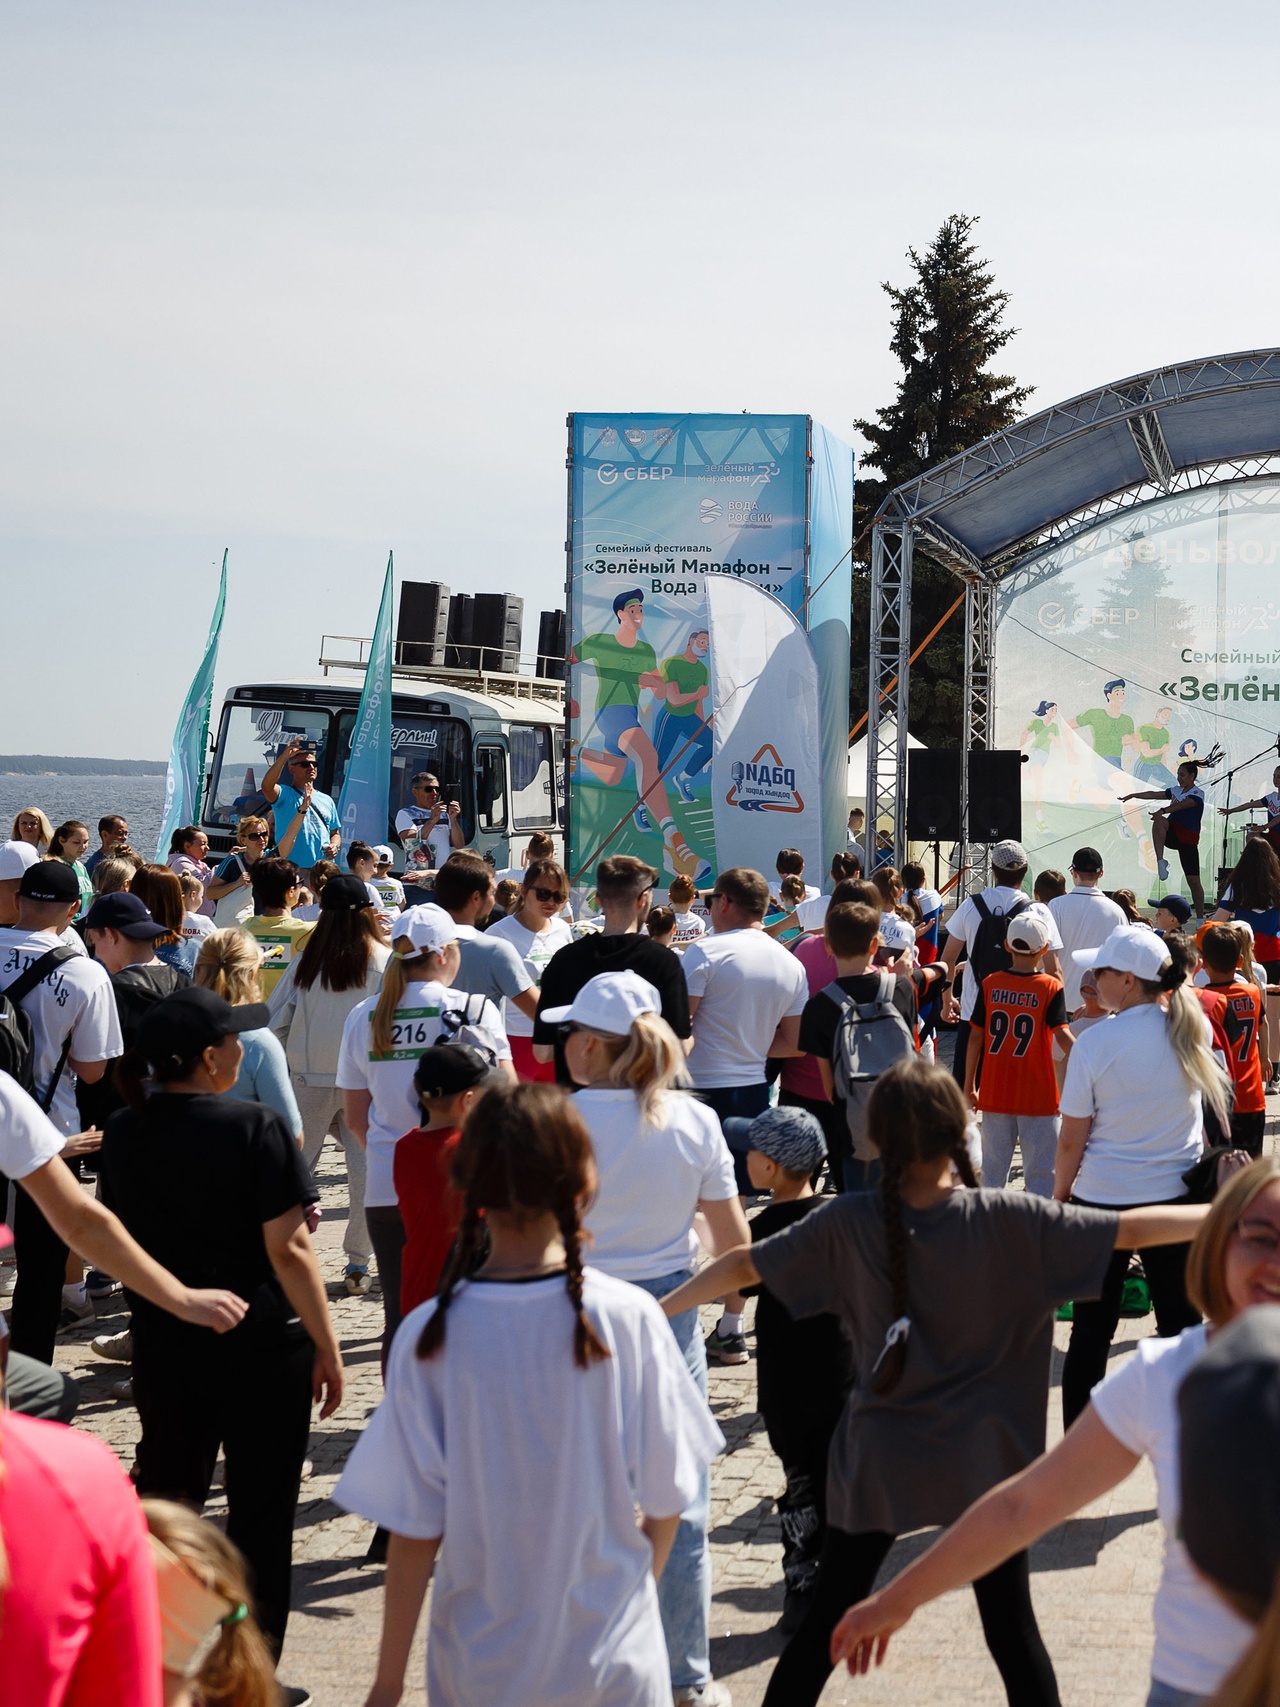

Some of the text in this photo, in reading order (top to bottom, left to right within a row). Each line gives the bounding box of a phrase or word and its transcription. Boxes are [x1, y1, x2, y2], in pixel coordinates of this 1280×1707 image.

[624, 466, 673, 480] СБЕР
[705, 462, 755, 473] зелёный
[697, 473, 750, 484] марафон
[728, 501, 759, 512] ВОДА
[728, 513, 773, 523] РОССИИ
[595, 543, 712, 555] Семейный фестиваль
[584, 558, 675, 574] «Зелёный
[682, 558, 770, 577] Марафон
[651, 579, 698, 595] Вода
[1073, 607, 1141, 625] СБЕР
[391, 725, 437, 750] ерлин!
[991, 988, 1039, 1008] ЮНОСТЬ
[988, 1009, 1036, 1058] 99
